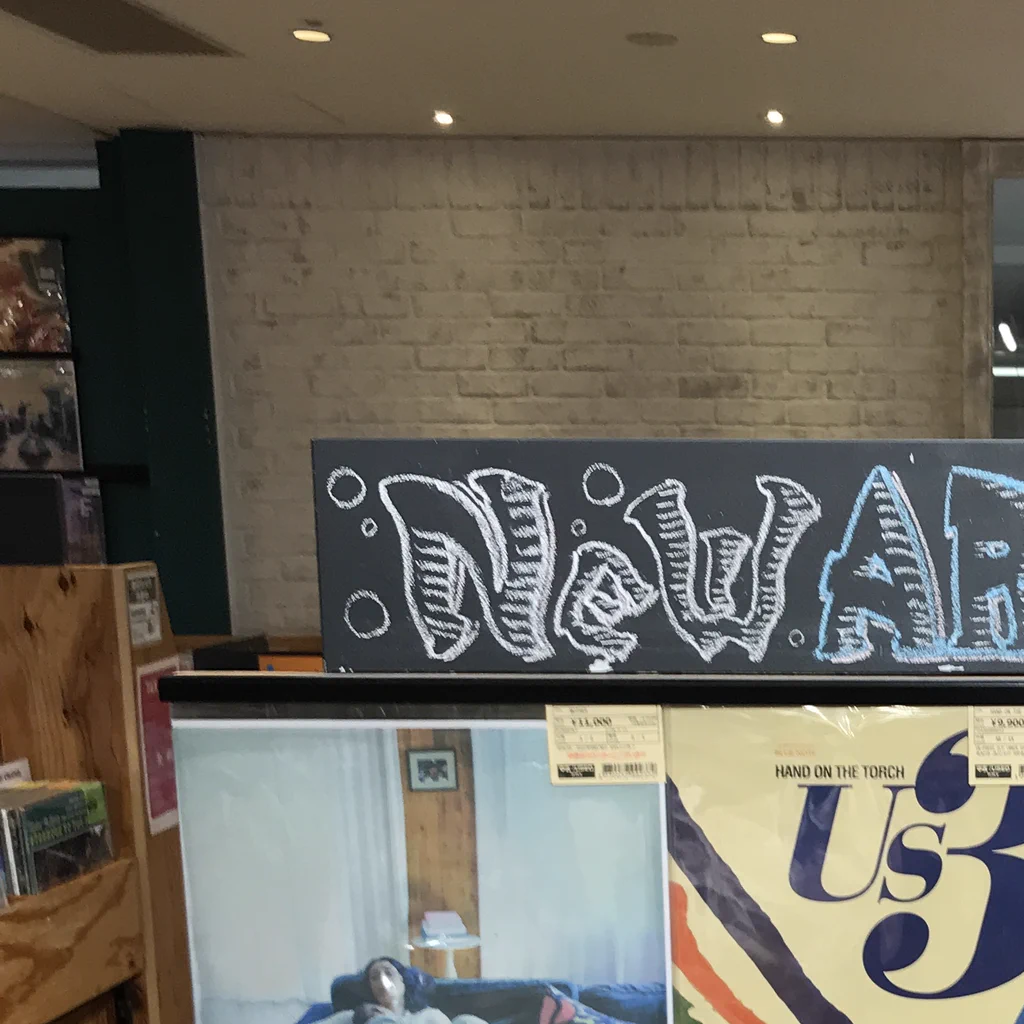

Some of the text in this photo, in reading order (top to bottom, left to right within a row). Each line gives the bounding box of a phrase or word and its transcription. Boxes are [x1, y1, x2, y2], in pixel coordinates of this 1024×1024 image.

[775, 765, 905, 779] HAND ON THE TORCH
